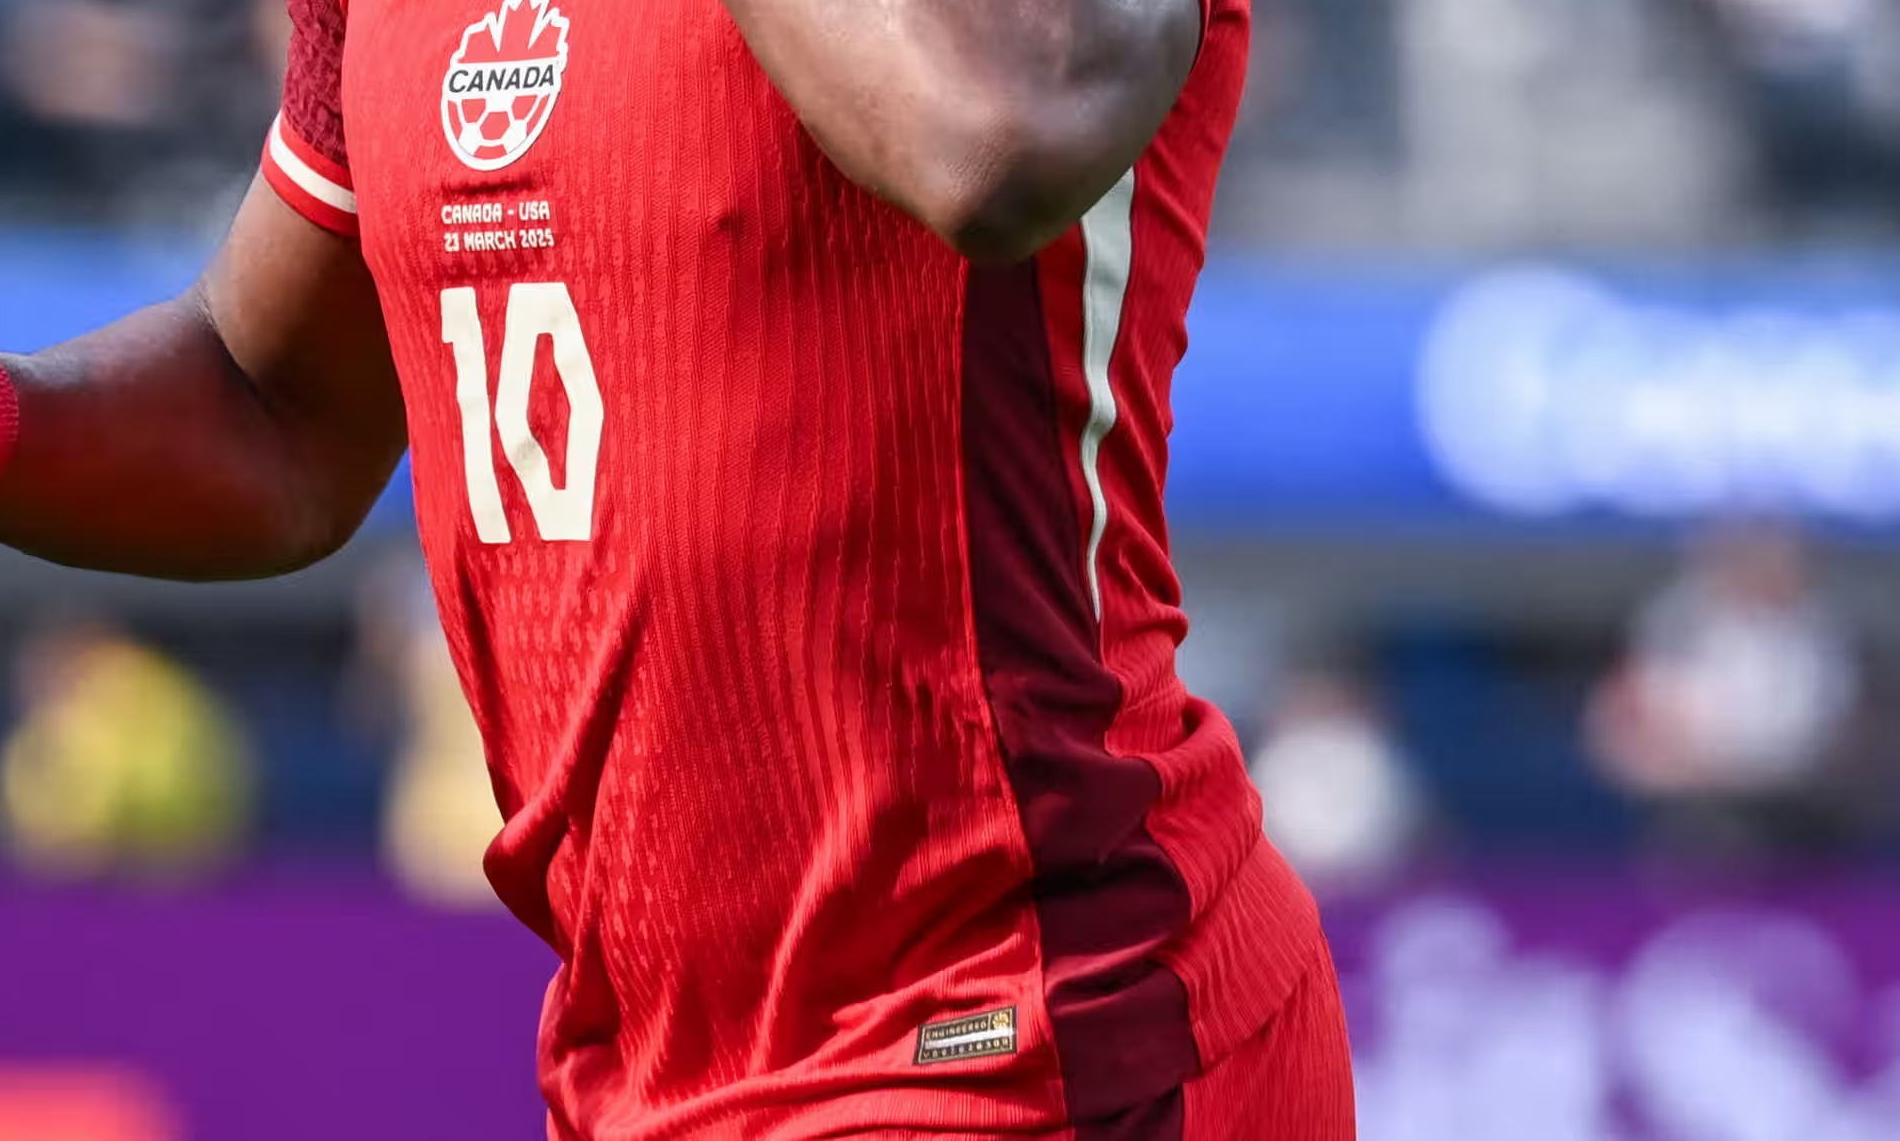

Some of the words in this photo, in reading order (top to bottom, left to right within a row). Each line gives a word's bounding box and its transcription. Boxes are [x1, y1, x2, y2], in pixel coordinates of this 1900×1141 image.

[448, 64, 554, 93] CANADA
[441, 203, 502, 224] CANADA
[519, 200, 550, 221] USA
[444, 232, 460, 252] 23
[463, 230, 517, 252] MARCH
[519, 228, 555, 248] 2025
[441, 282, 603, 543] 10
